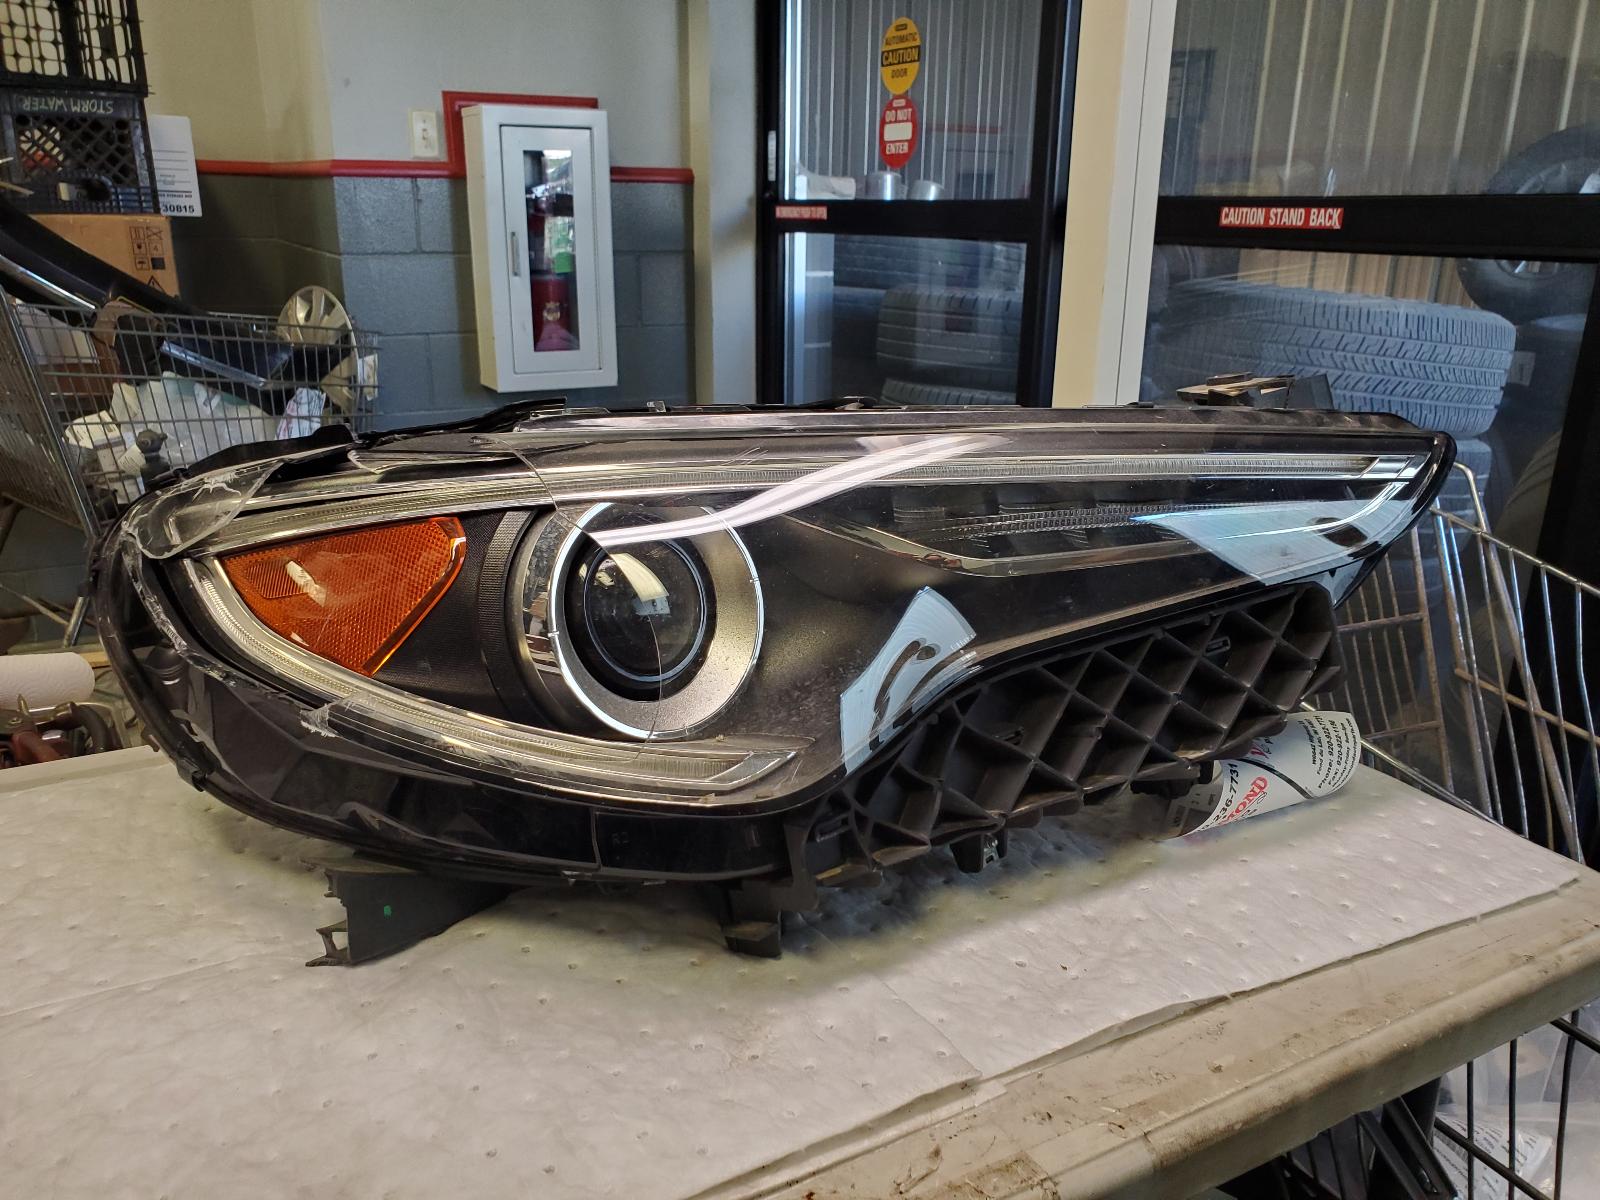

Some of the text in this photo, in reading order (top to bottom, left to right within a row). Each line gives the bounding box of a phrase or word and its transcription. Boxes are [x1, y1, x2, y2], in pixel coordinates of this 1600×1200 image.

[885, 32, 918, 46] AUTOMATIC
[882, 47, 918, 66] CAUTION
[891, 68, 908, 79] DOOR
[22, 95, 114, 114] STORM WATER
[885, 108, 912, 123] DO NOT
[1221, 207, 1341, 227] CAUTION STAND BACK
[1318, 758, 1334, 789] Phone:
